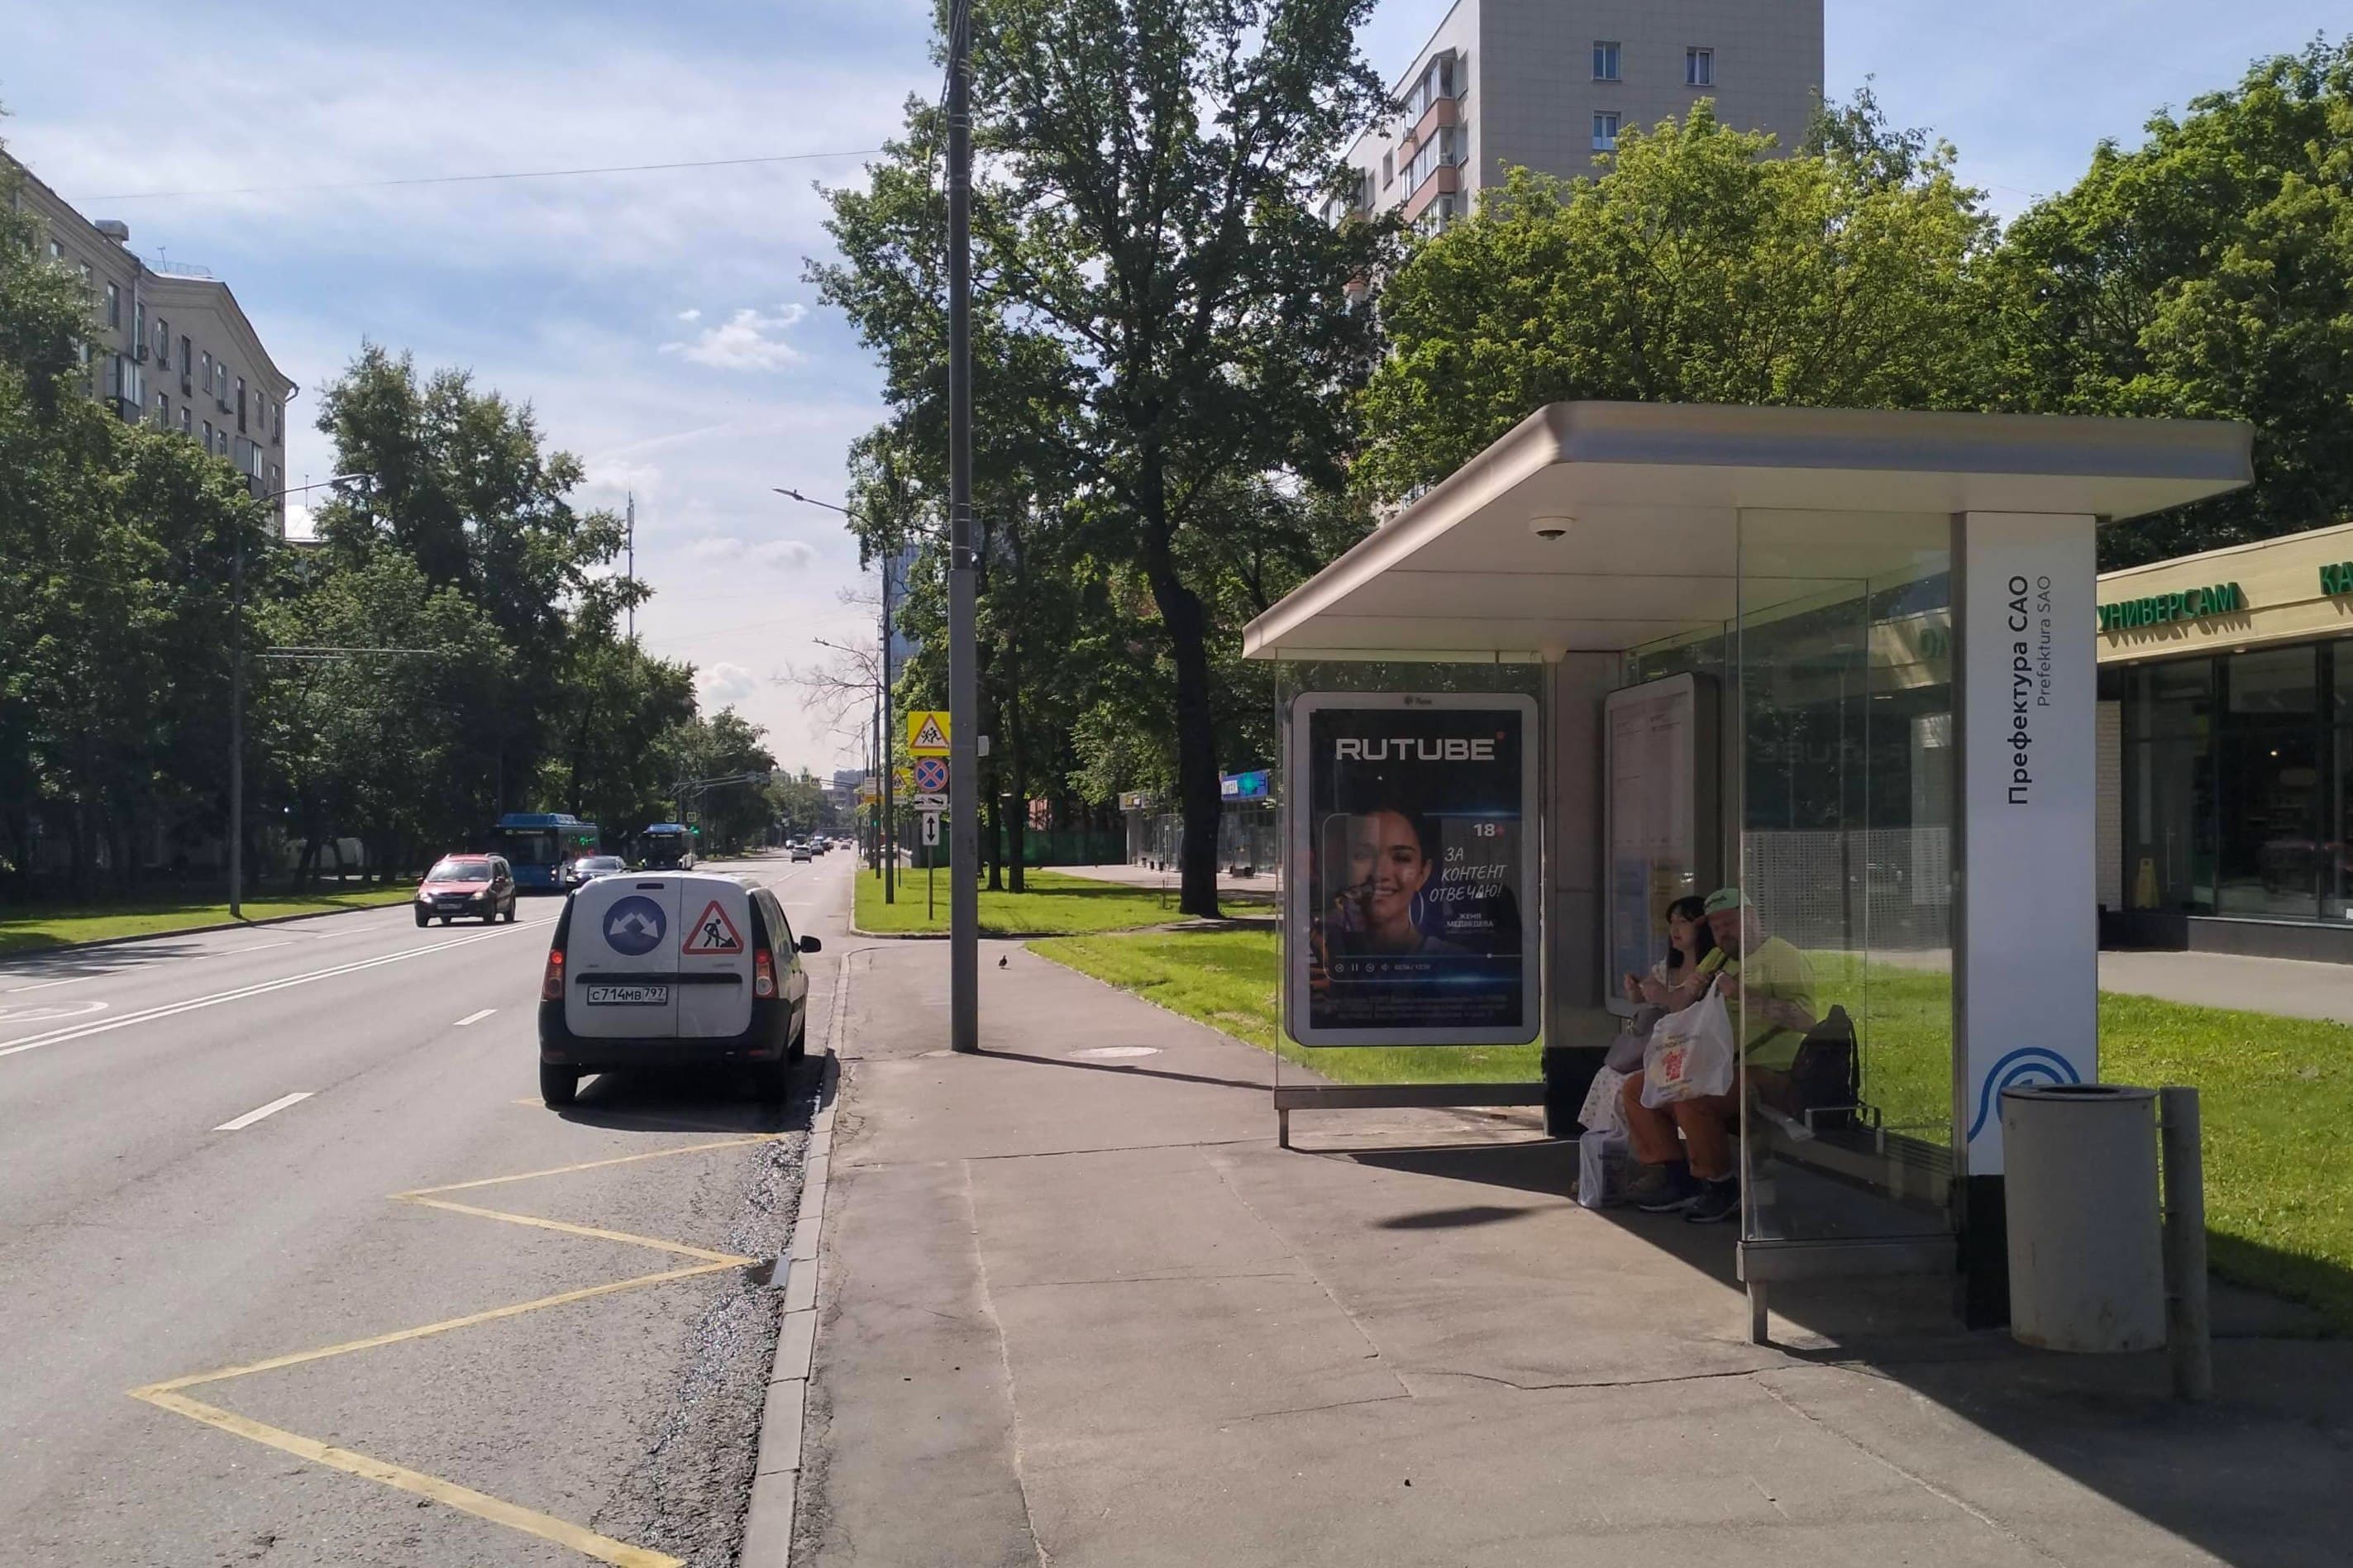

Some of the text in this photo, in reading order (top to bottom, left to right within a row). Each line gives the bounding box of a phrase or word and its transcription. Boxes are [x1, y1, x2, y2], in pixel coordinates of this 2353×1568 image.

[2097, 582, 2239, 631] УНИВЕРСАМ
[2036, 575, 2050, 706] Prefektura SAO
[2007, 575, 2032, 804] Префектура САО
[1335, 738, 1496, 760] RUTUBE
[1444, 846, 1464, 861] ЗА
[1441, 864, 1507, 882] КОНТЕНТ
[1429, 884, 1502, 903] ОТВЕЧАЮ!
